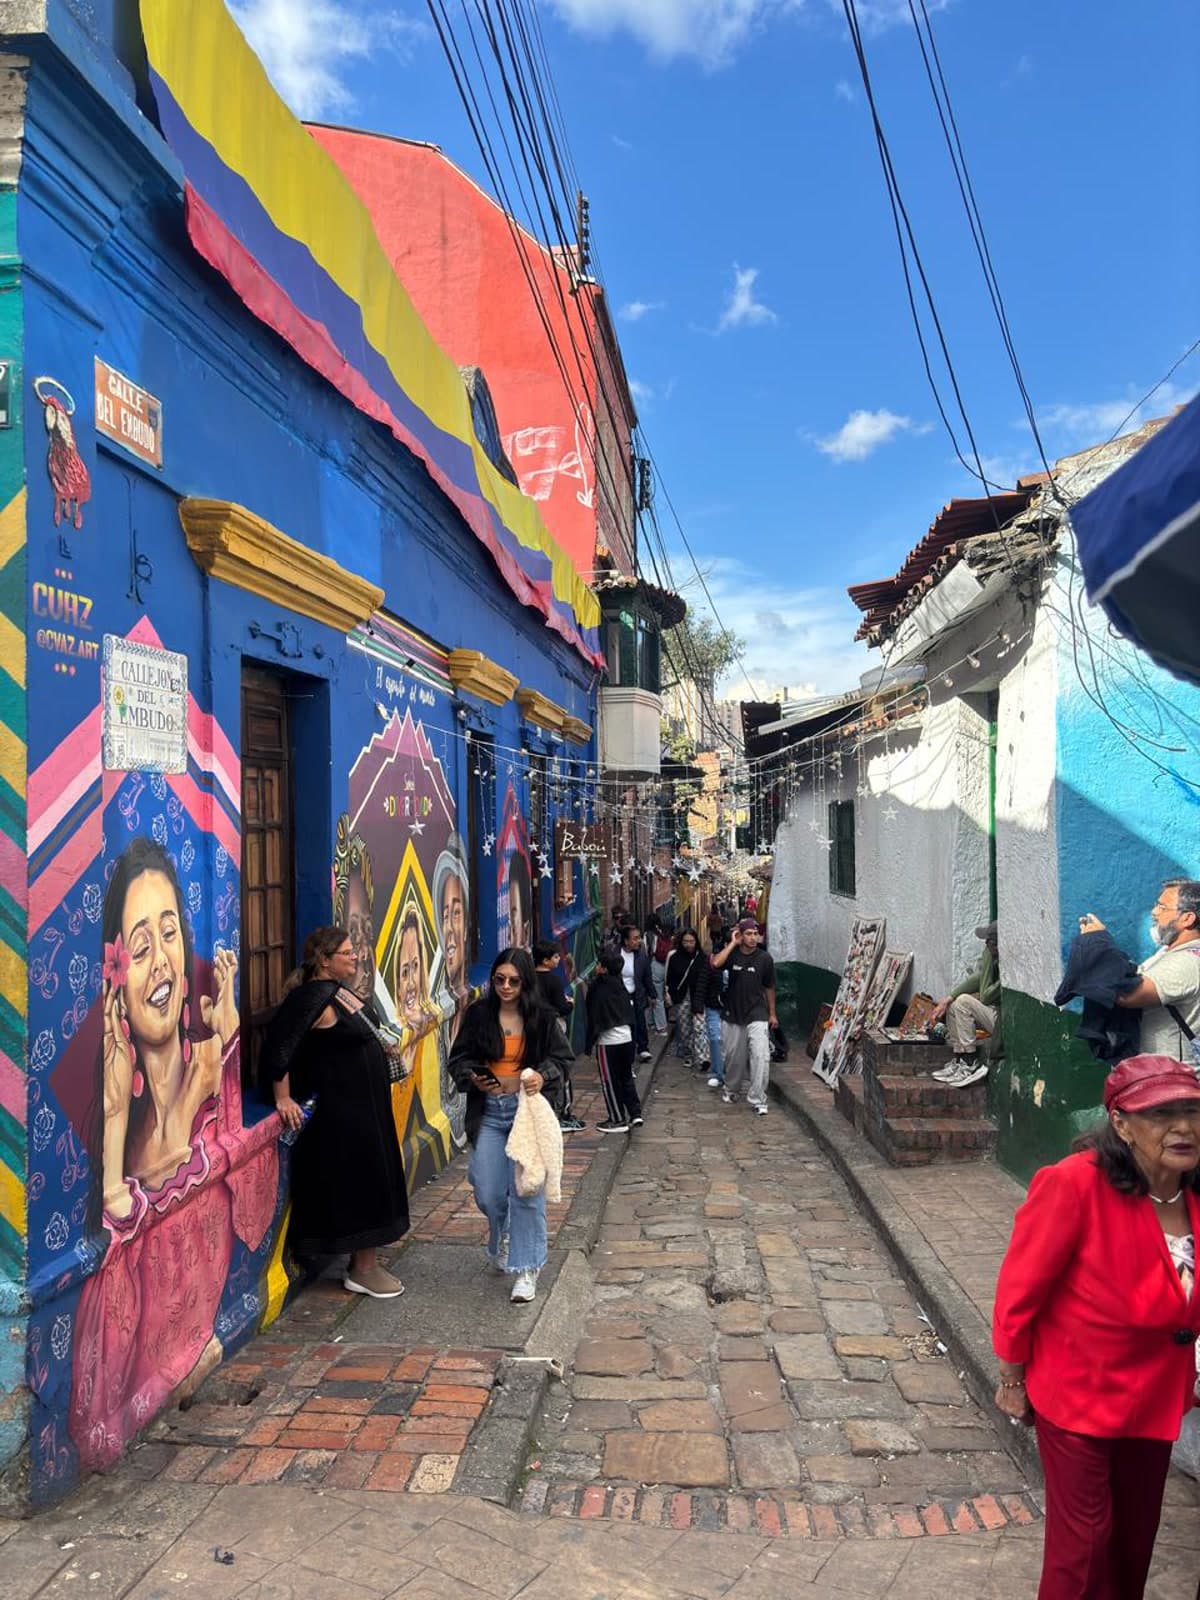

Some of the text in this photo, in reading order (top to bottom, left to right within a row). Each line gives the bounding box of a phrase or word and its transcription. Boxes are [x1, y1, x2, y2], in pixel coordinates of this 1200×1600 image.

[108, 374, 144, 414] CALLE
[96, 390, 155, 454] DEL EMBUDO
[137, 689, 156, 705] DEL
